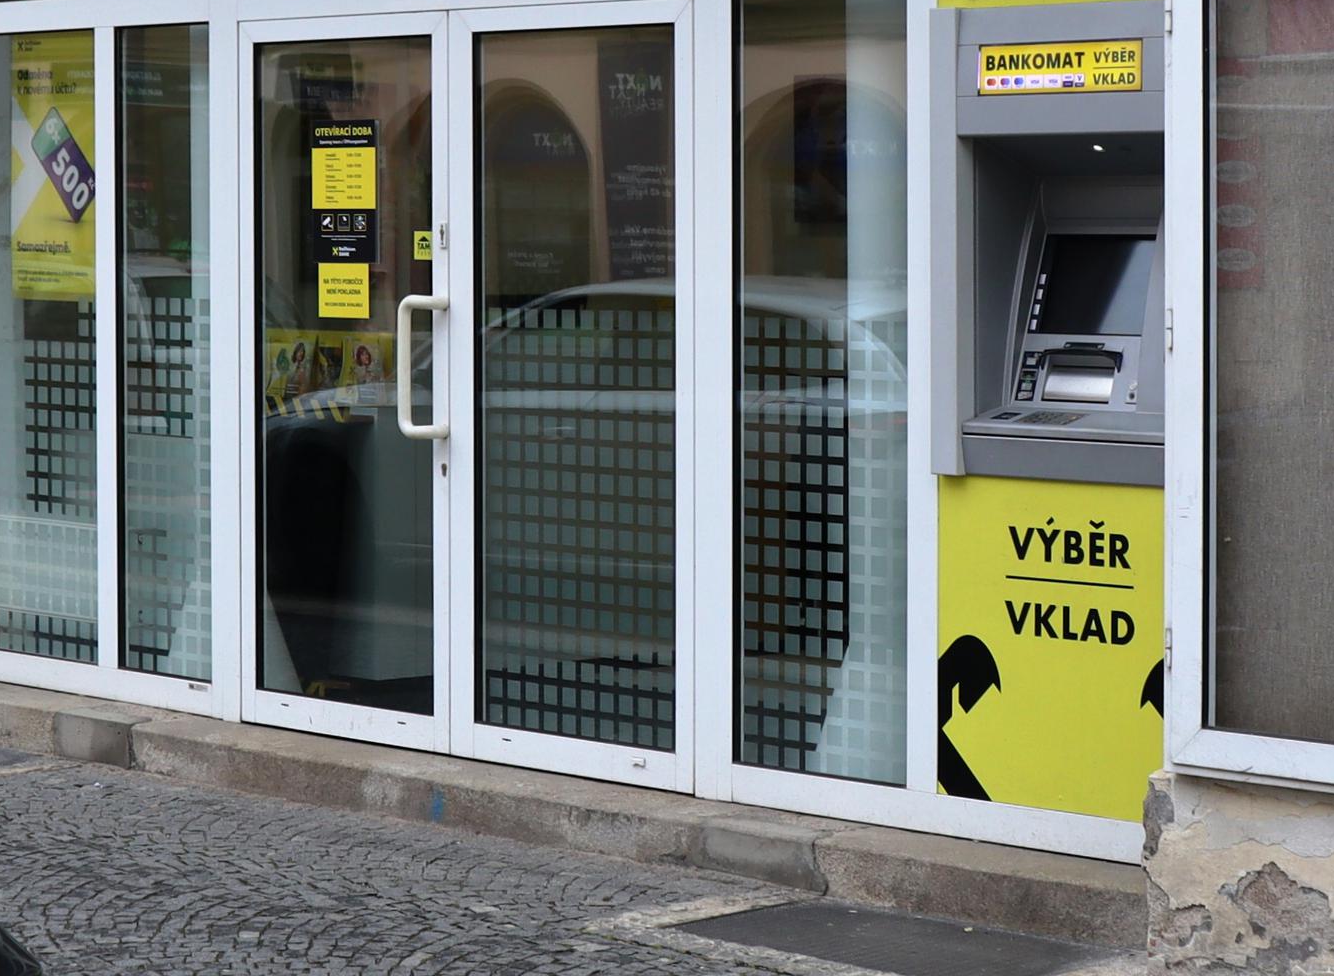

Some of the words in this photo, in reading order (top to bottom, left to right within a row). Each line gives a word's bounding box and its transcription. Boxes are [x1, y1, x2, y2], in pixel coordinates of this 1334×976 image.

[985, 52, 1085, 71] BANKOMAT
[1093, 47, 1136, 64] VÝBĚR
[1093, 72, 1136, 86] VKLAD
[352, 127, 372, 136] DOBA
[52, 147, 89, 210] 500
[1008, 516, 1132, 569] VÝBĚR
[1004, 600, 1136, 646] VKLAD
